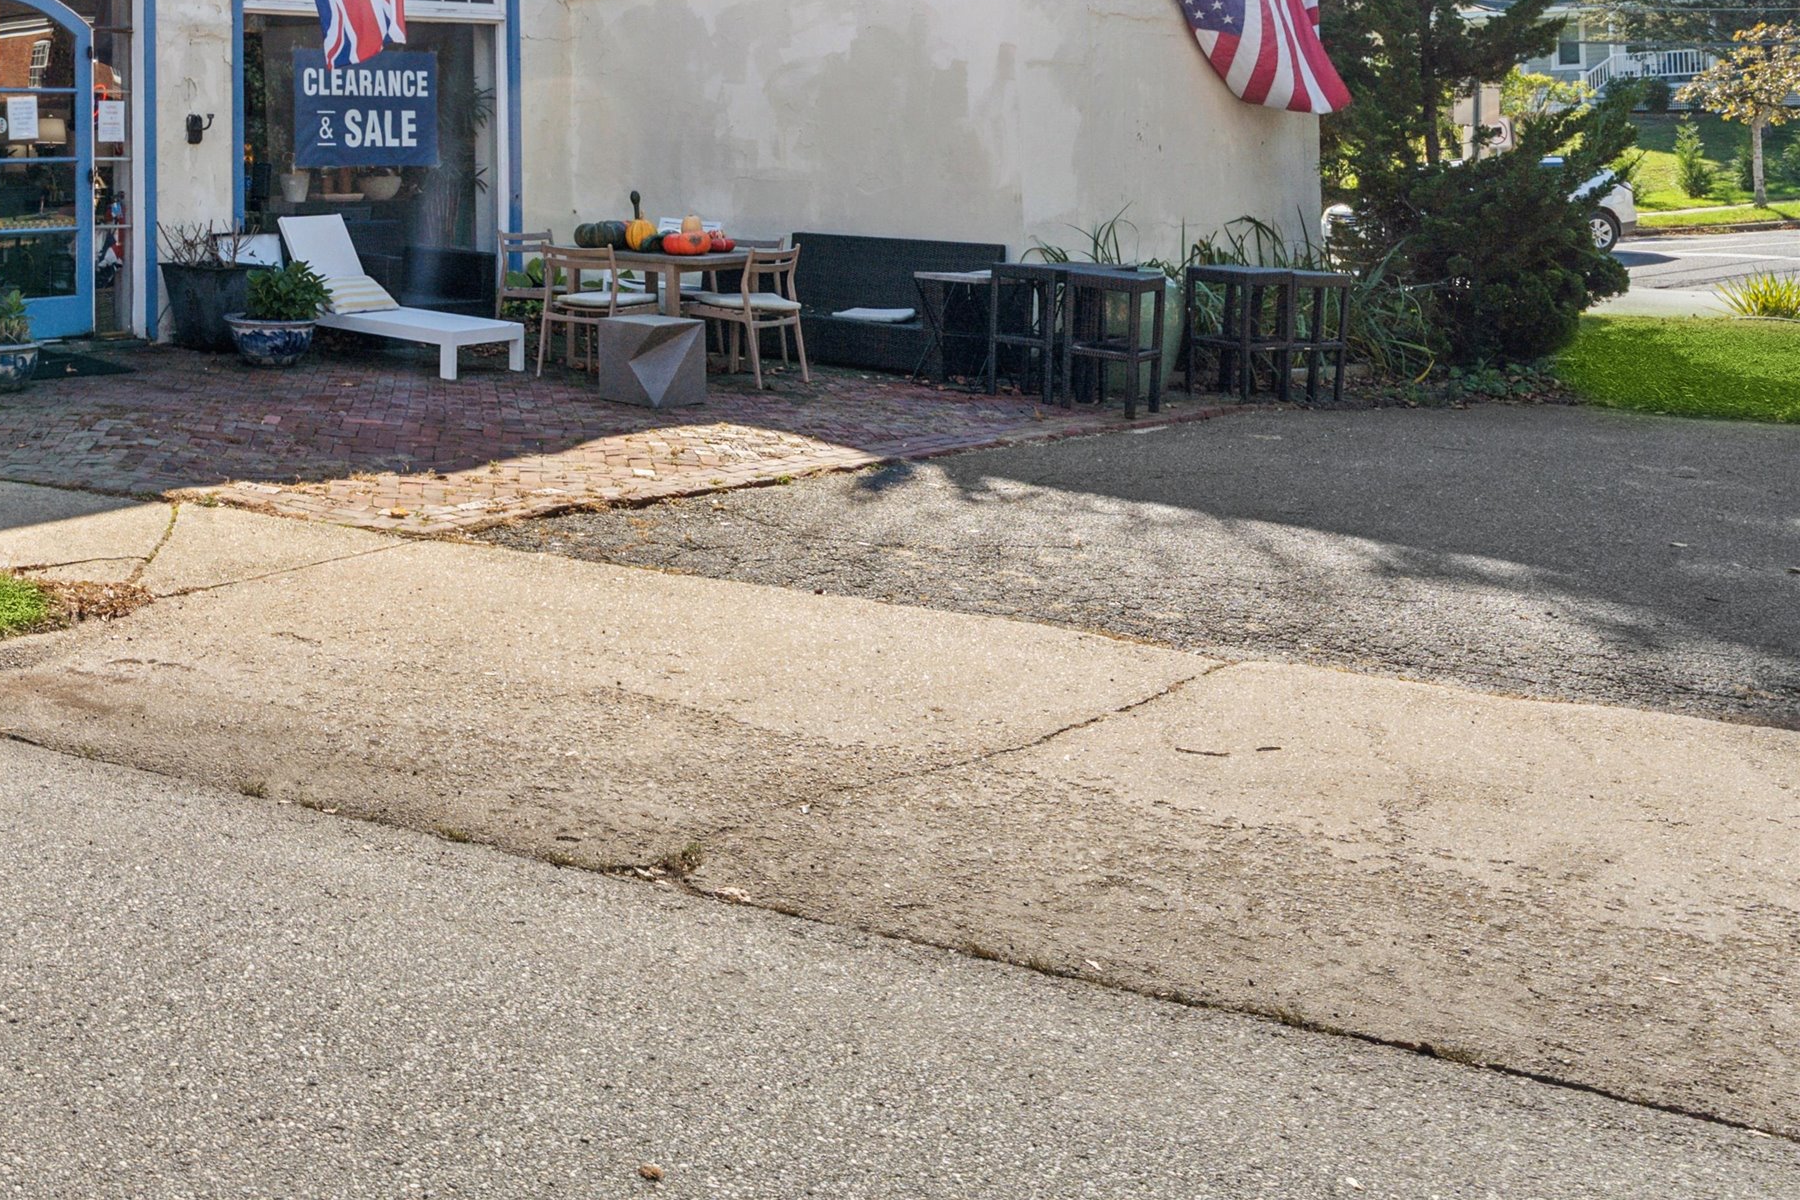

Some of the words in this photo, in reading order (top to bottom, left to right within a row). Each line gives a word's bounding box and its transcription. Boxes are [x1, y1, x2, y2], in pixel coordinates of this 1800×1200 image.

[303, 67, 429, 98] CLEARANCE
[319, 116, 334, 140] &
[344, 108, 418, 149] SALE
